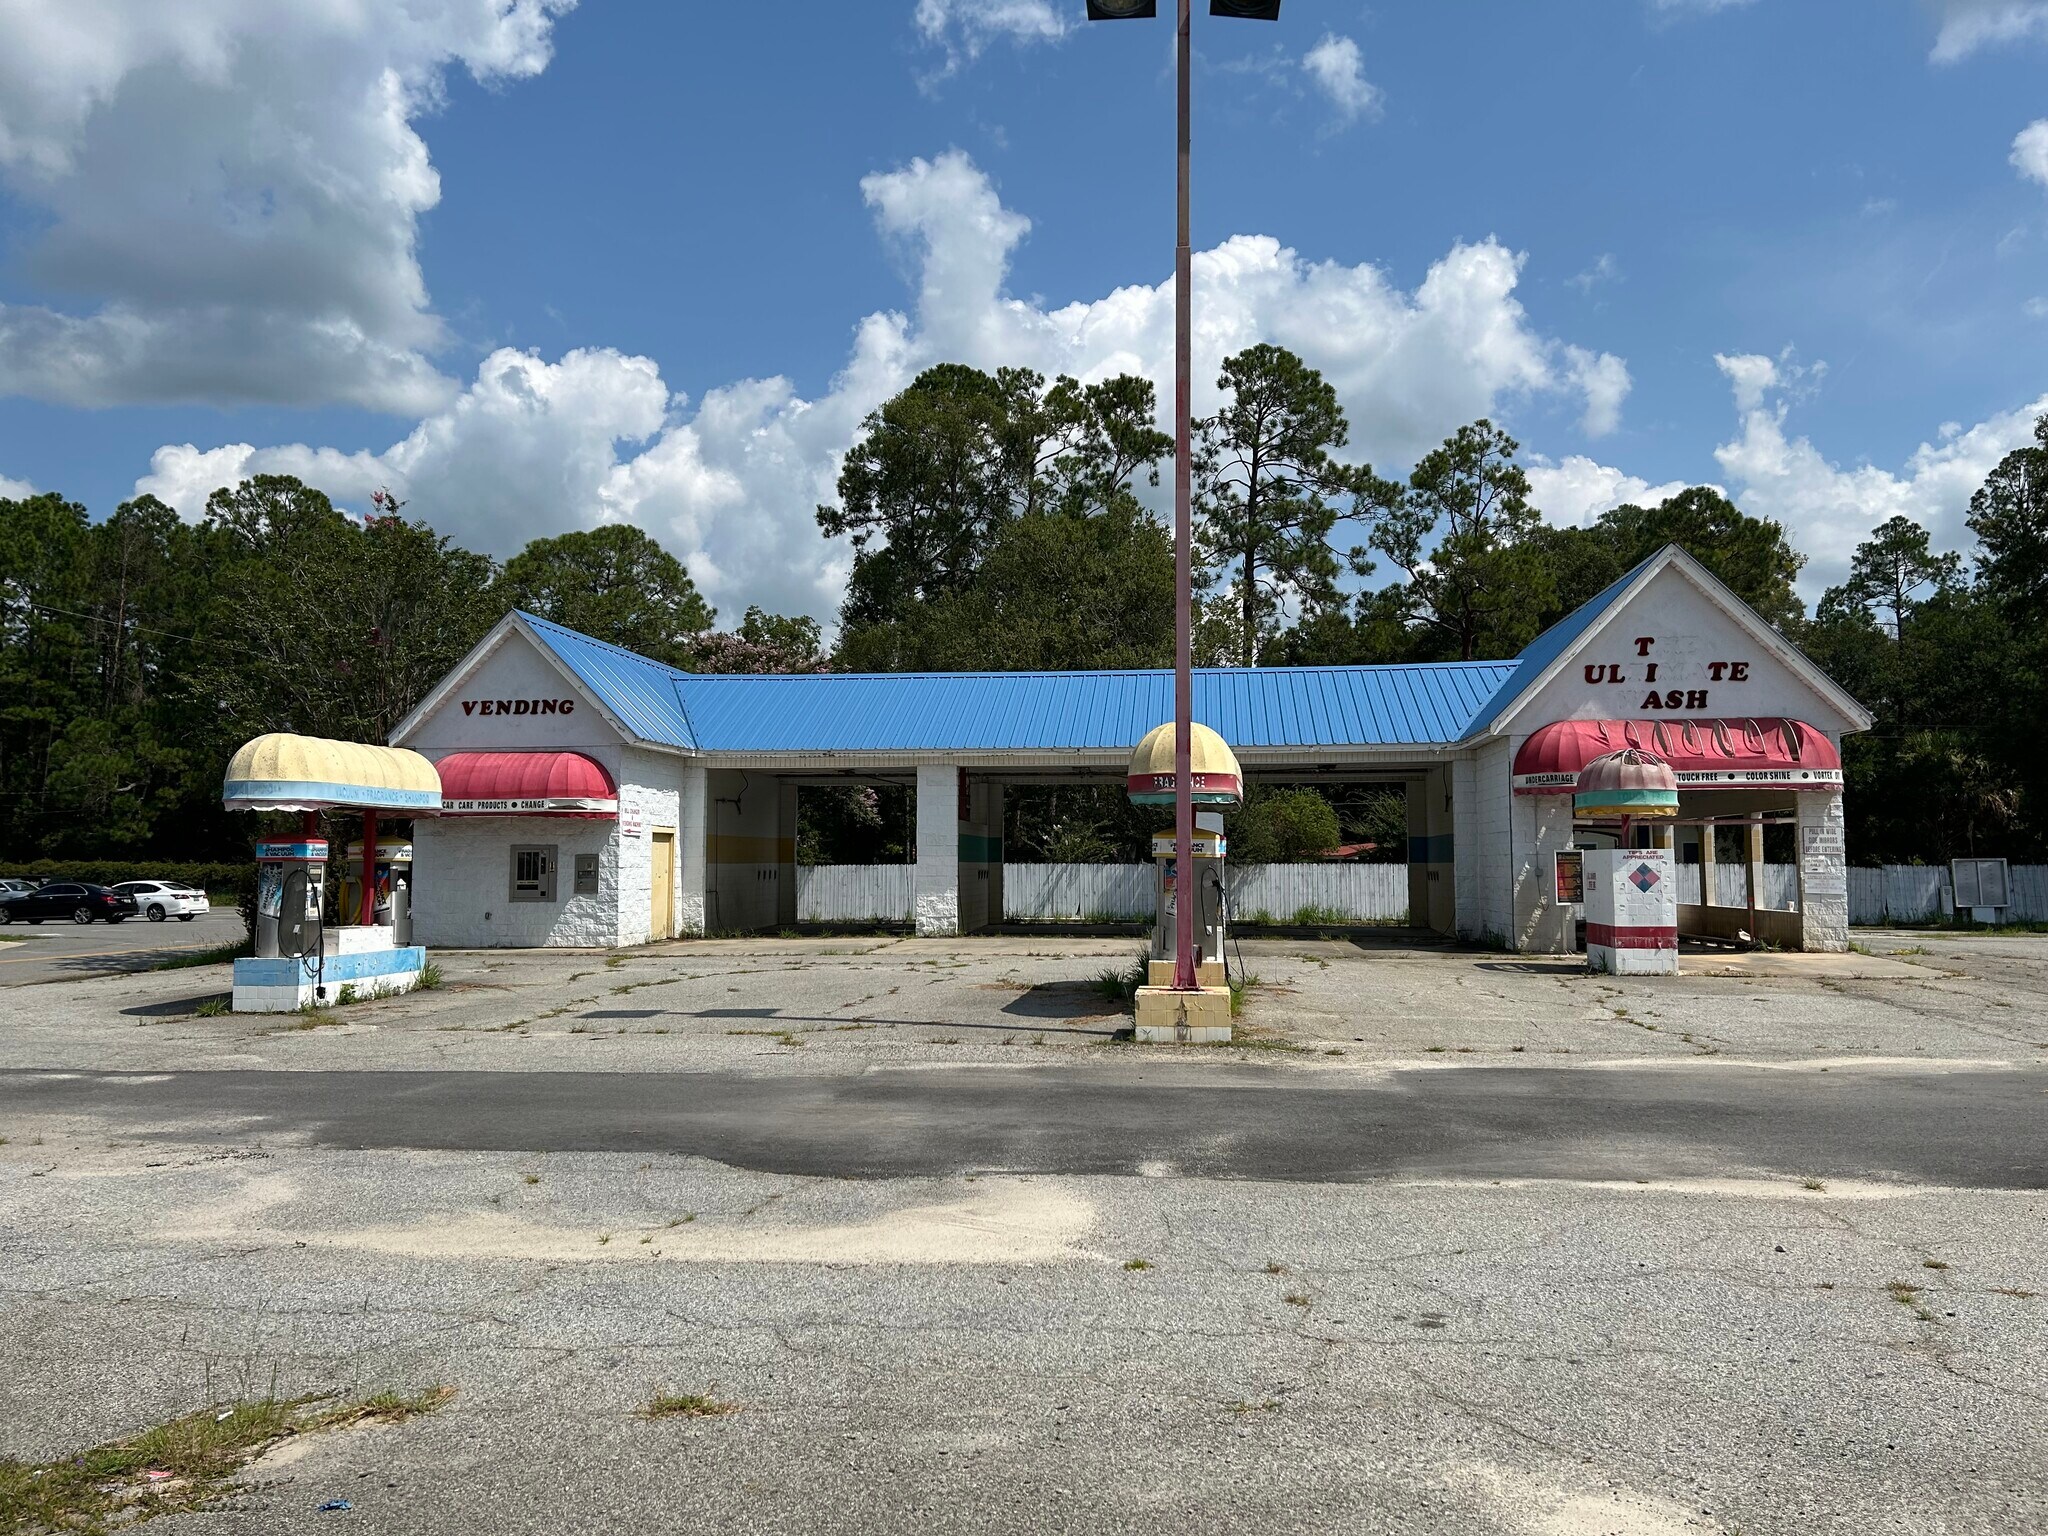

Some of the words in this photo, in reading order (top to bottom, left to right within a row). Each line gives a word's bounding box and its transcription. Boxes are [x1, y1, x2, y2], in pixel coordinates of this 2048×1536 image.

[461, 699, 575, 716] VENDING
[1525, 773, 1574, 784] UNDERCARRIAGE
[1677, 772, 1699, 782] TOUCH
[1701, 772, 1718, 781] FREE
[1745, 771, 1768, 781] COLOR
[1769, 771, 1791, 780] SHINE
[1812, 770, 1833, 780] VORTEX
[442, 800, 454, 810] CAR
[458, 800, 474, 810] CARE
[477, 800, 508, 810] PRODUCTS
[520, 799, 545, 810] CHANGE
